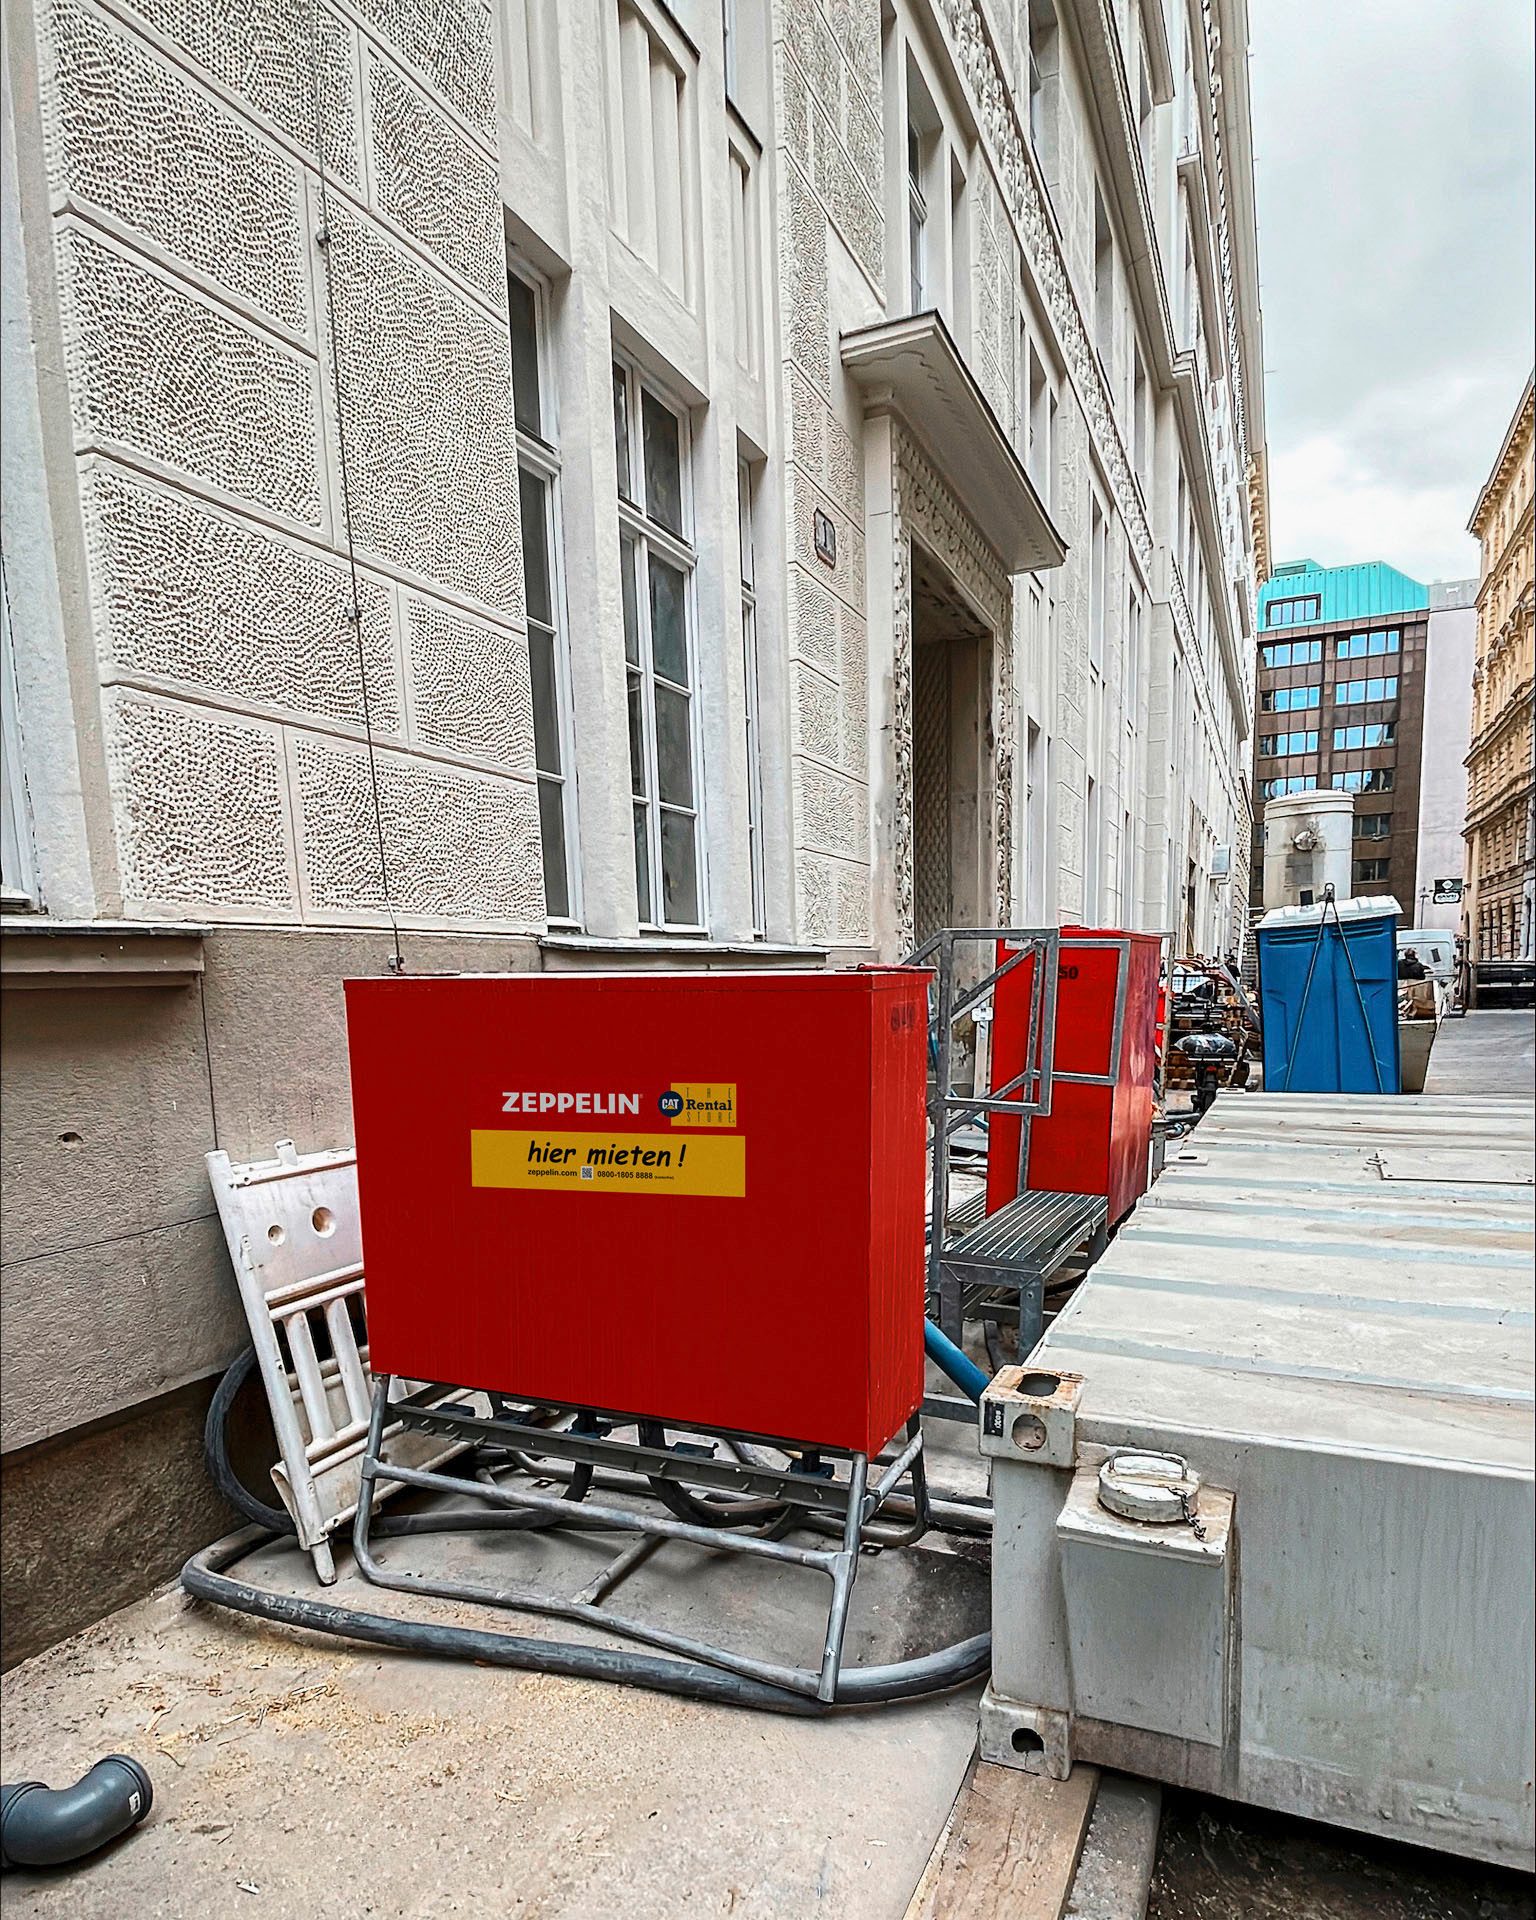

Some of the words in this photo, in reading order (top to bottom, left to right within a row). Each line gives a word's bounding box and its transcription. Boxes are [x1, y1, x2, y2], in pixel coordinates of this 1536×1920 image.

[501, 1091, 640, 1115] ZEPPELIN
[661, 1098, 680, 1110] CAT
[685, 1098, 733, 1111] Rental
[527, 1140, 577, 1164] hier
[527, 1168, 578, 1178] zeppelin.com
[597, 1170, 634, 1179] 0800-1805
[635, 1171, 653, 1180] 8888
